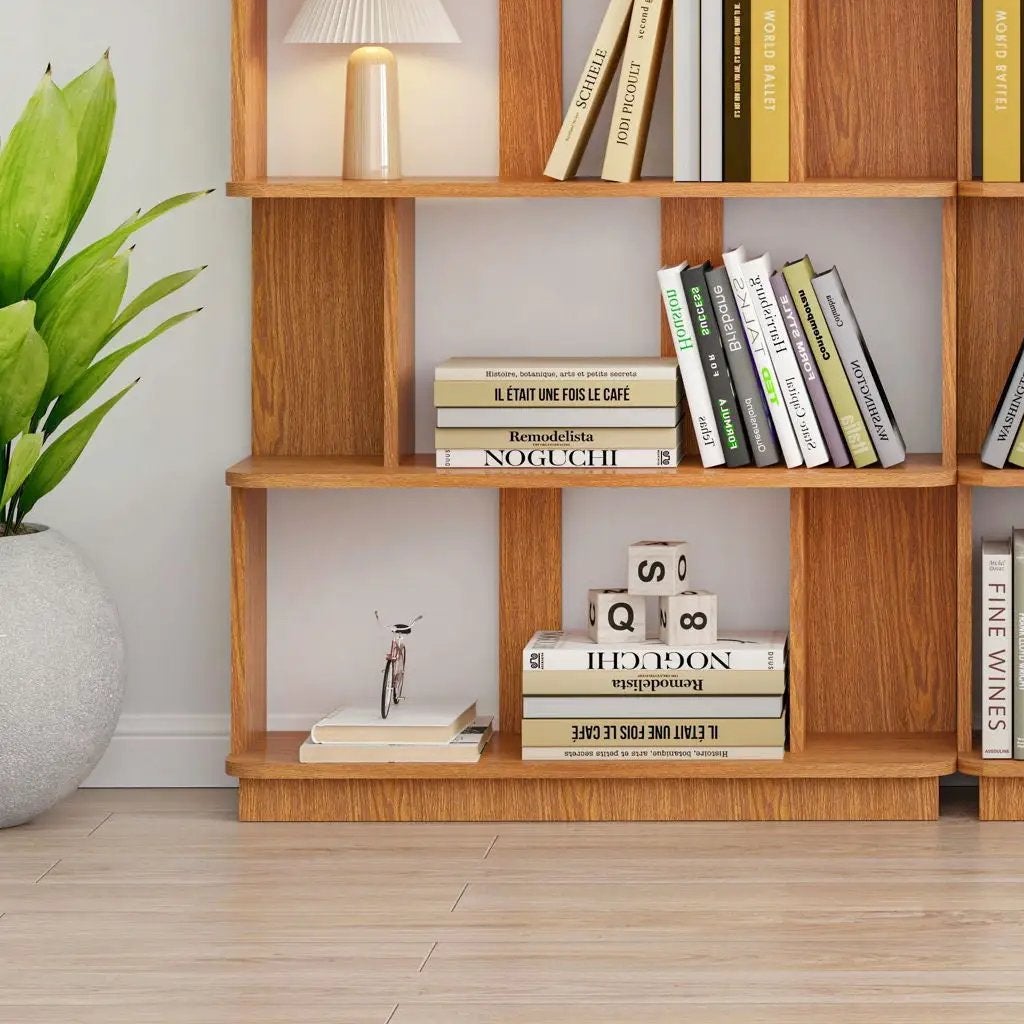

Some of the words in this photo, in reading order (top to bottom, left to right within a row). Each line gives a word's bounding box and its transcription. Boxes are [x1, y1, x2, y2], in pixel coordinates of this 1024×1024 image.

[636, 6, 650, 39] second
[763, 10, 776, 58] WORLD
[575, 48, 608, 109] SCHIELE
[622, 60, 642, 114] PICOULT
[764, 65, 776, 112] BALLET
[616, 116, 632, 146] JODI
[519, 371, 558, 379] botanique,
[586, 371, 608, 380] petits
[494, 388, 504, 401] IL
[506, 384, 535, 401] ÉTAIT
[539, 388, 560, 401] UNE
[562, 388, 585, 401] FOIS
[588, 388, 600, 401] LE
[603, 384, 630, 401] CAFÉ
[509, 430, 594, 442] Remodelista
[484, 449, 618, 467] NOGUCHI
[638, 559, 666, 583] S
[607, 602, 635, 633] Q
[988, 583, 1006, 637] FINE
[679, 611, 708, 631] 8
[587, 651, 732, 670] NOGUCHI
[611, 678, 703, 691] Remodelista
[988, 649, 1006, 731] WINES
[571, 725, 601, 743] CAFÉ
[603, 725, 617, 739] LE
[620, 725, 645, 739] FOIS
[648, 725, 670, 739] UNE
[674, 725, 705, 743] ÉTAIT
[708, 725, 718, 739] IL
